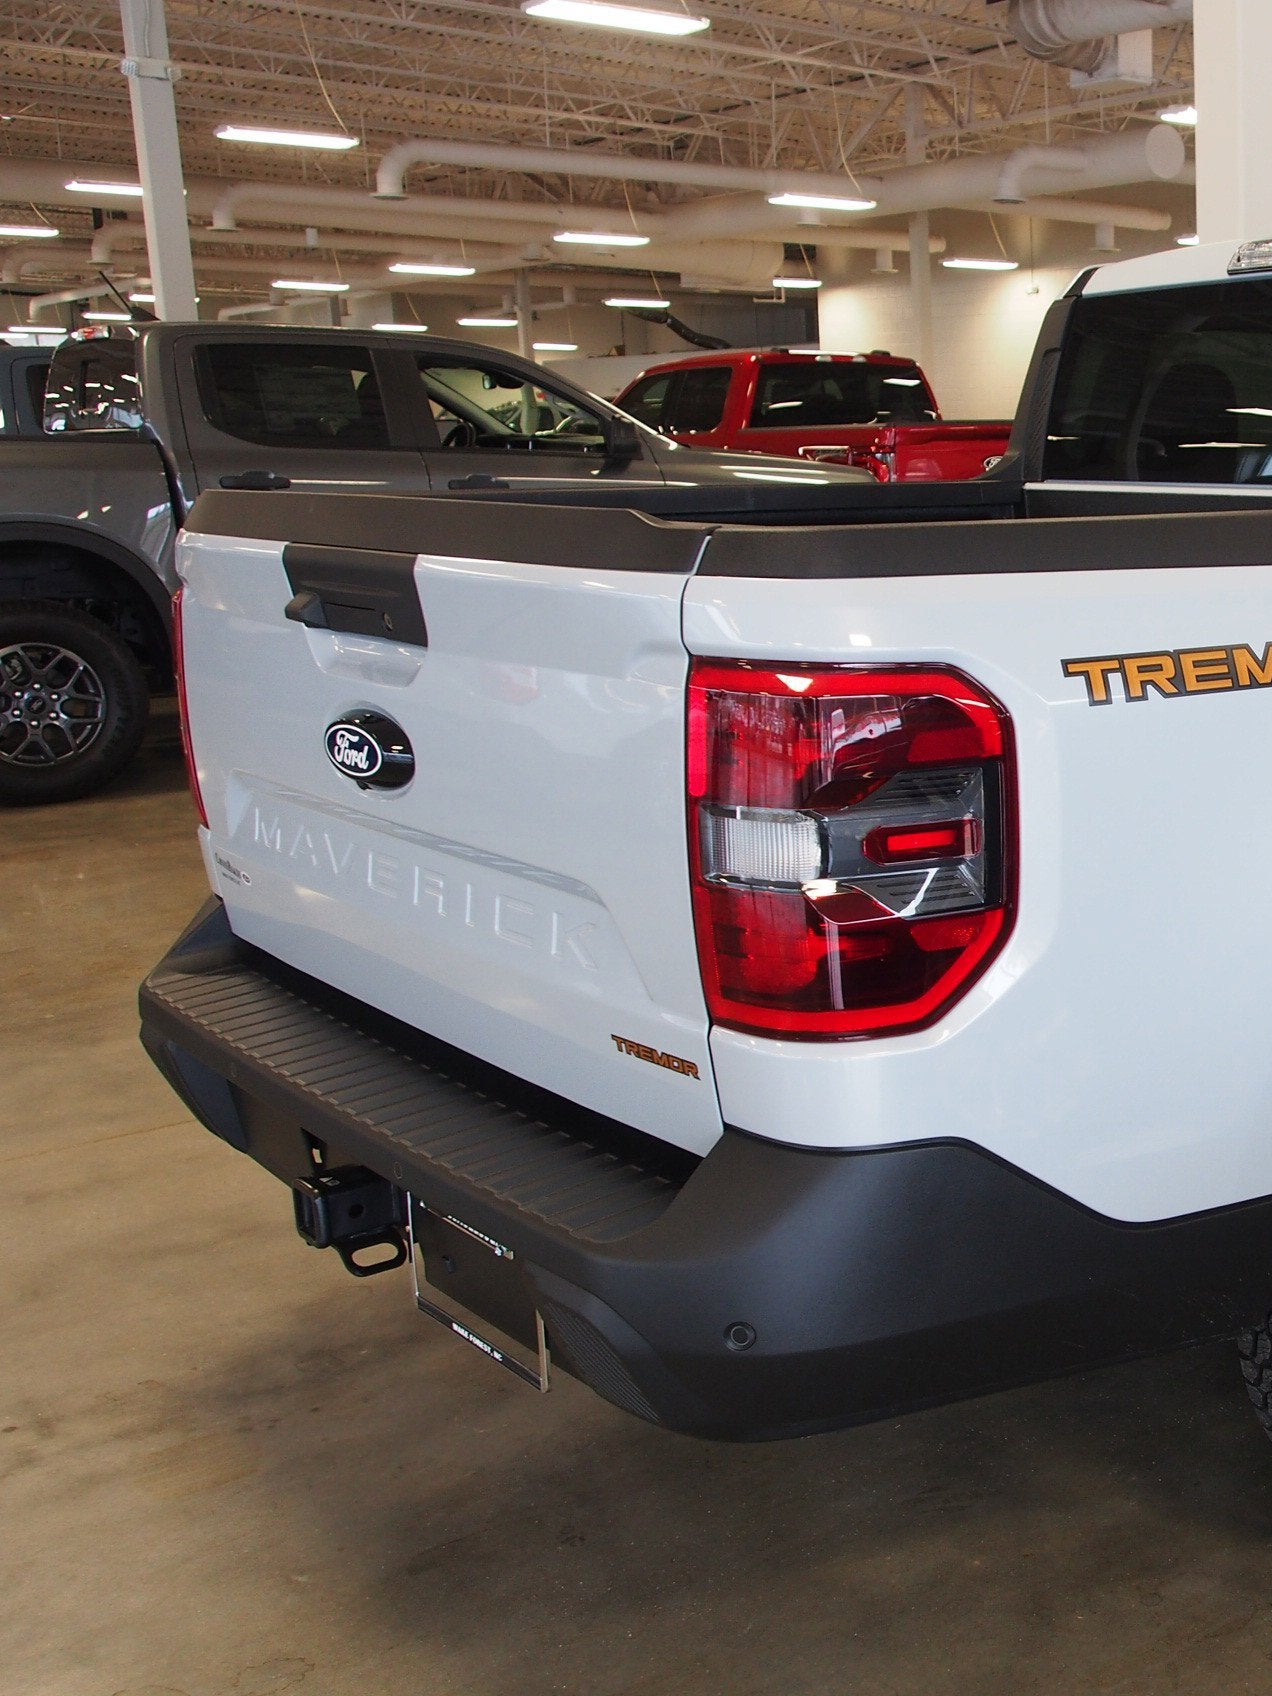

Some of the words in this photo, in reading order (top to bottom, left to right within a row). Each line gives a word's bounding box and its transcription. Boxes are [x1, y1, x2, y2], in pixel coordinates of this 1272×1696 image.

[334, 730, 369, 769] Ford
[254, 806, 599, 972] MAVERICK
[610, 1034, 701, 1080] TREMOR
